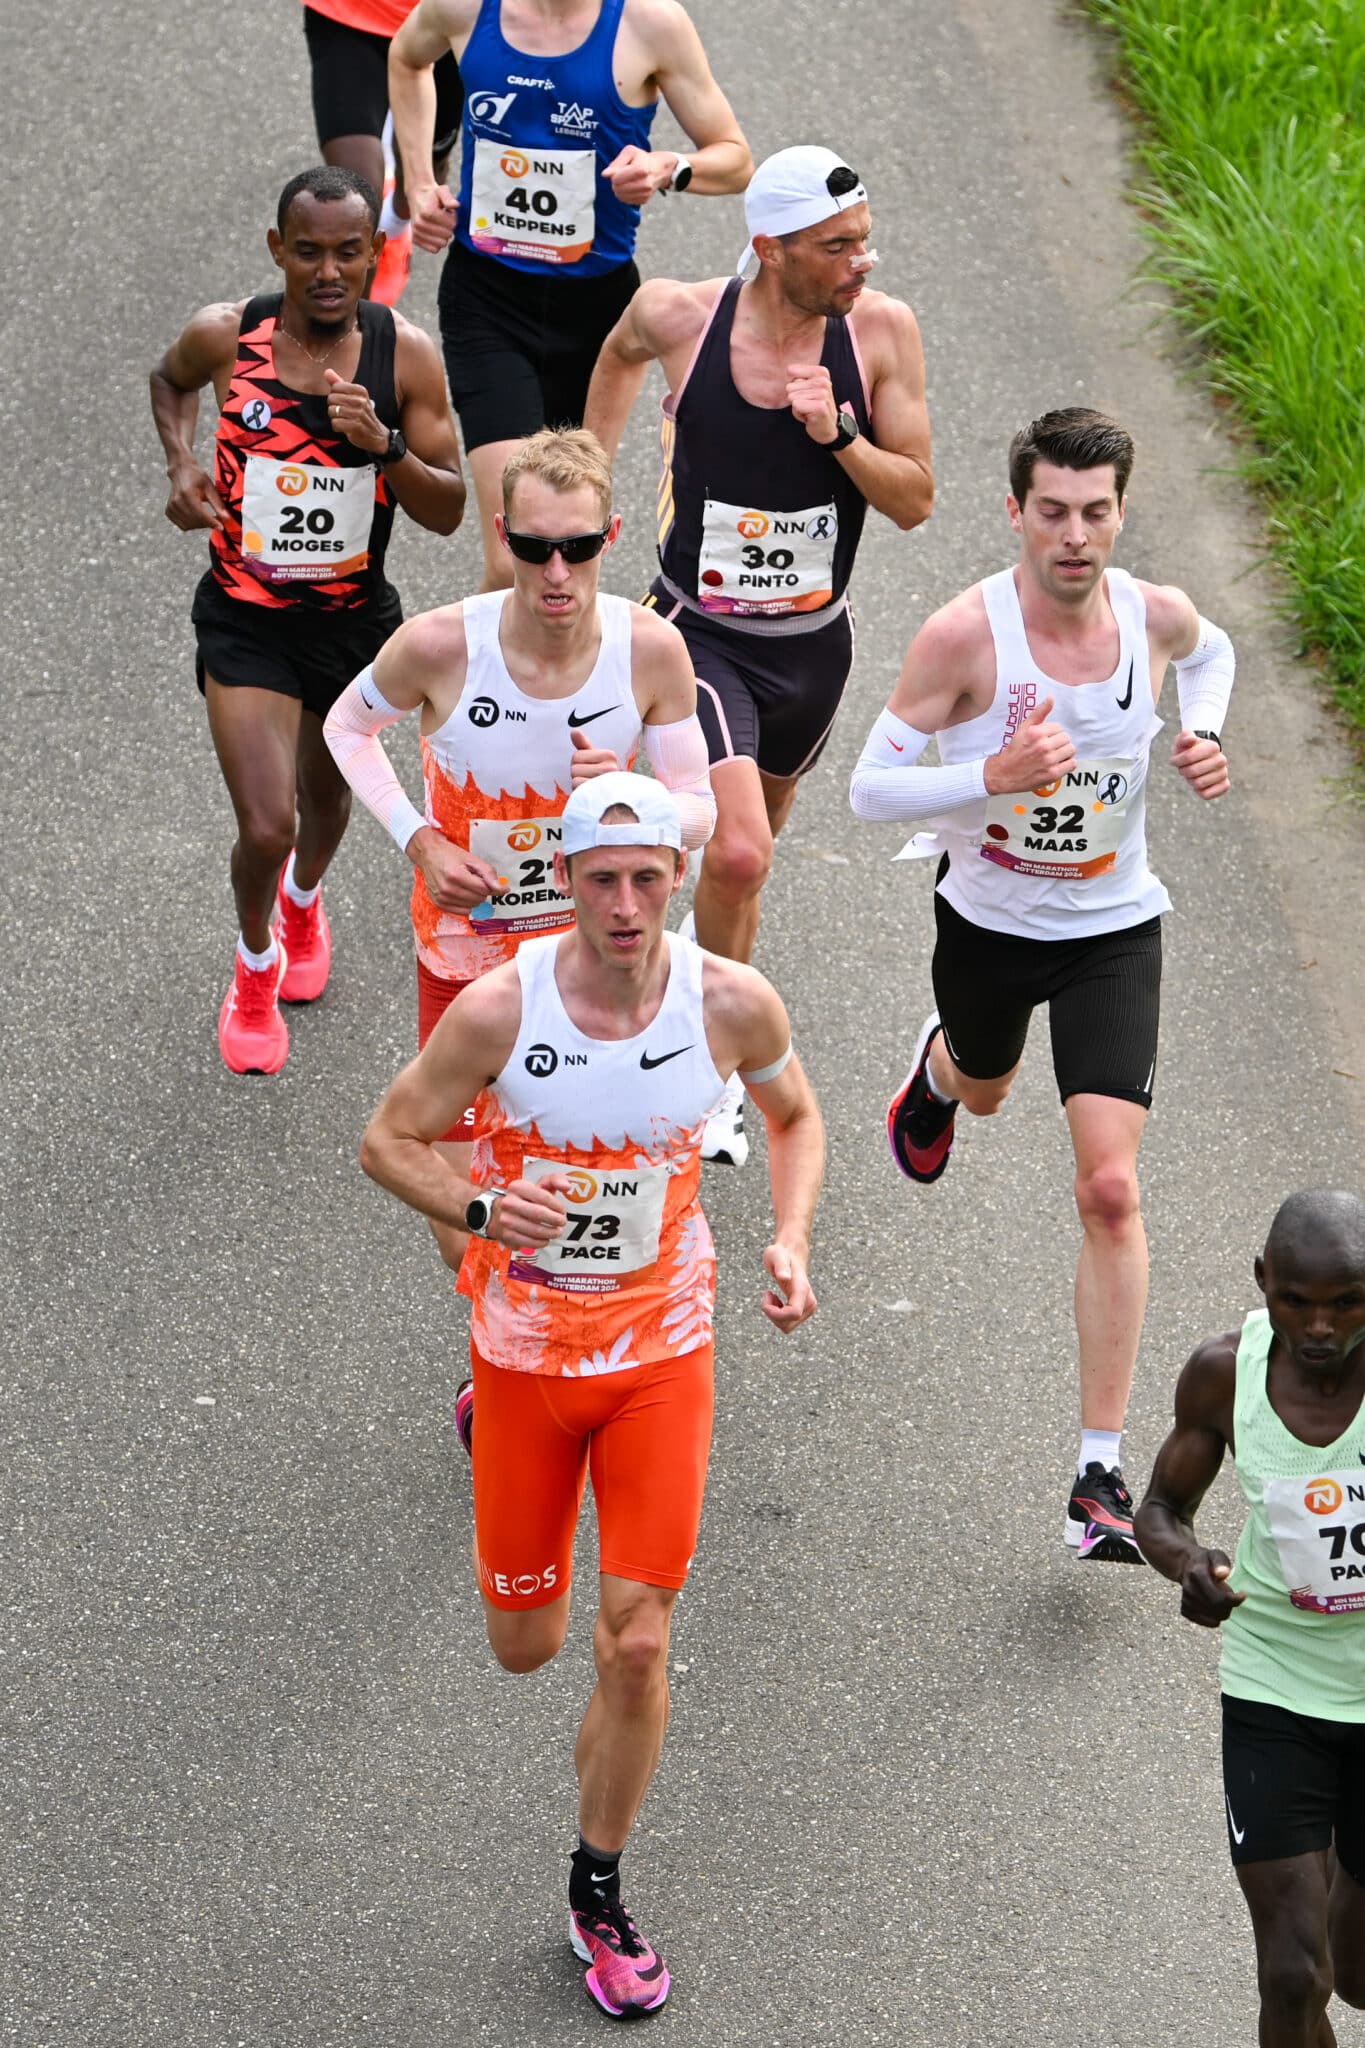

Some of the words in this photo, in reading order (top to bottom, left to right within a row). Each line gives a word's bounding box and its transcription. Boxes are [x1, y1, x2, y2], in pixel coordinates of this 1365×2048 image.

[507, 75, 545, 88] CRAFT
[557, 102, 593, 120] TAP
[534, 160, 564, 175] NN
[505, 187, 557, 216] 40
[494, 212, 576, 236] KEPPENS
[312, 476, 344, 492] NN
[279, 506, 334, 535] 20
[774, 521, 805, 534] NN
[272, 538, 344, 552] MOGES
[742, 545, 794, 570] 30
[739, 573, 799, 588] PINTO
[505, 710, 527, 722] NN
[1066, 771, 1099, 787] NN
[1030, 805, 1085, 834] 32
[546, 828, 562, 841] N
[1024, 836, 1088, 851] MAAS
[1014, 864, 1063, 877] ROTTERDAM
[1033, 863, 1079, 872] MARATHON
[491, 889, 572, 906] KOREM
[507, 922, 556, 932] ROTTERDAM
[527, 914, 570, 925] MARATHON
[564, 1054, 587, 1066] NN
[602, 1182, 638, 1197] NN
[566, 1212, 621, 1241] 73
[560, 1246, 621, 1260] PACE
[547, 1281, 600, 1292] ROTTERDAM
[600, 1284, 620, 1292] 2024
[567, 1277, 616, 1285] MARATHON
[1331, 1564, 1365, 1580] PA
